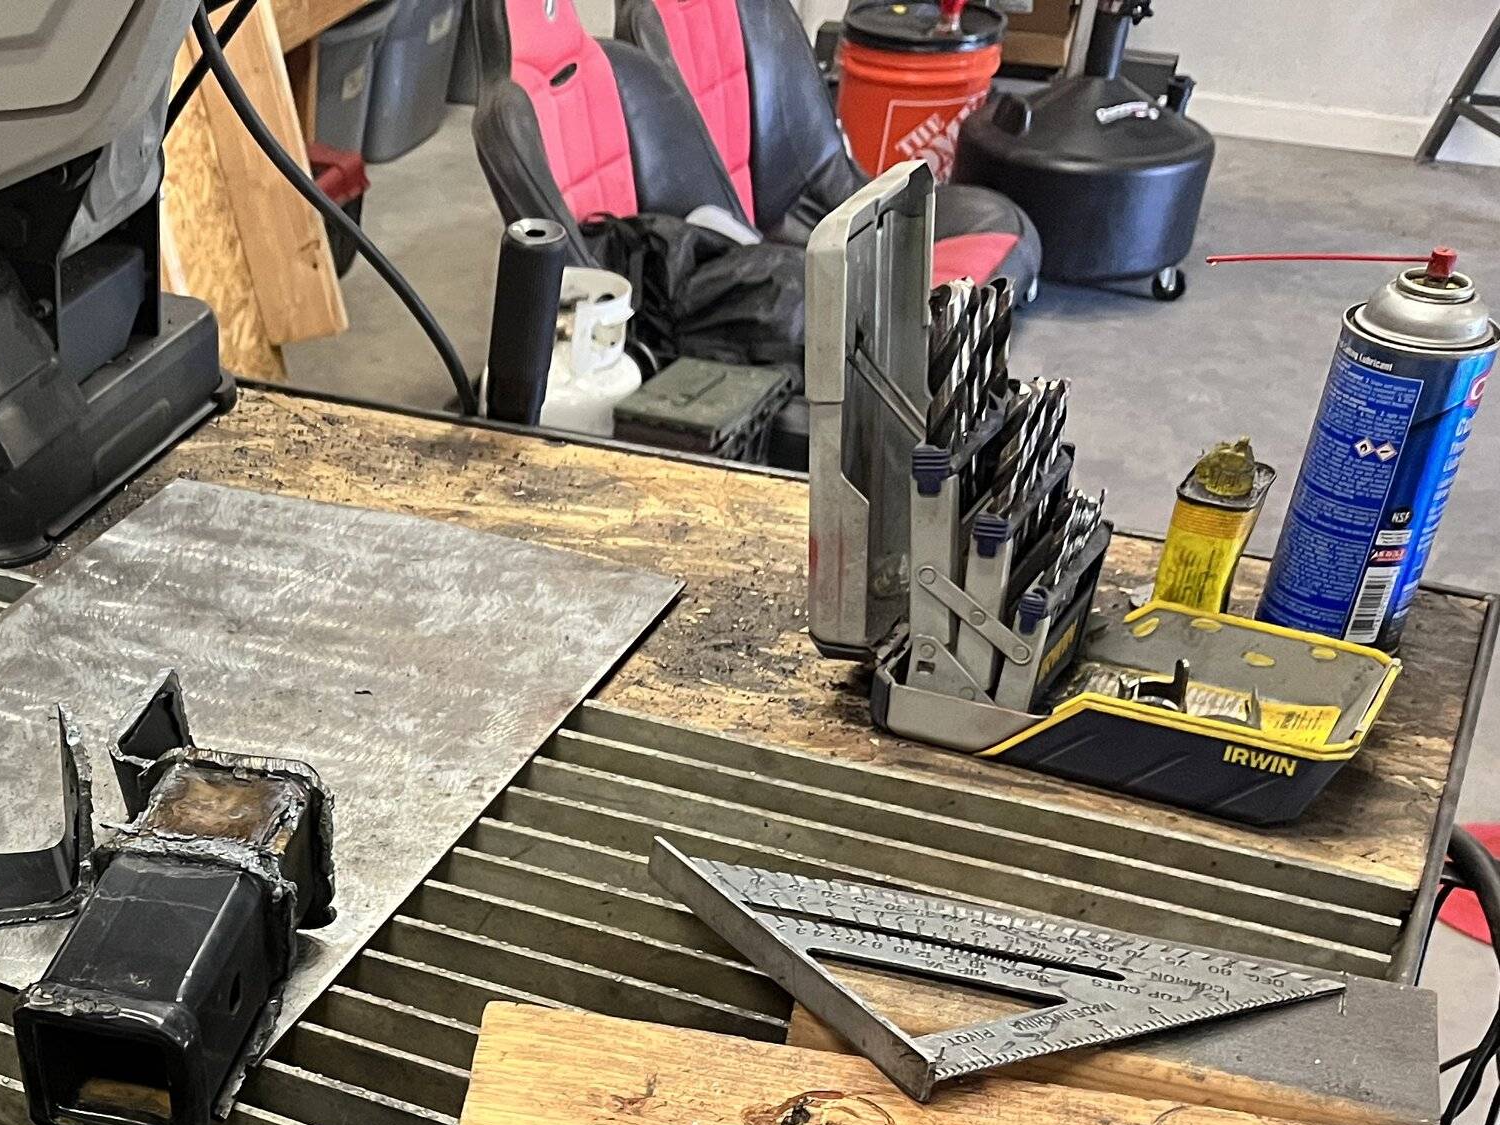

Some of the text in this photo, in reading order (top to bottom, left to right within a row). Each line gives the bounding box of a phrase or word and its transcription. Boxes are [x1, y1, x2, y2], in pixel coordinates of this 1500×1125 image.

[895, 113, 944, 156] THE
[1223, 745, 1298, 777] IRWIN
[1091, 978, 1184, 1003] TOP CUTS
[1150, 971, 1225, 994] COMMON
[948, 1026, 997, 1047] PIVOT
